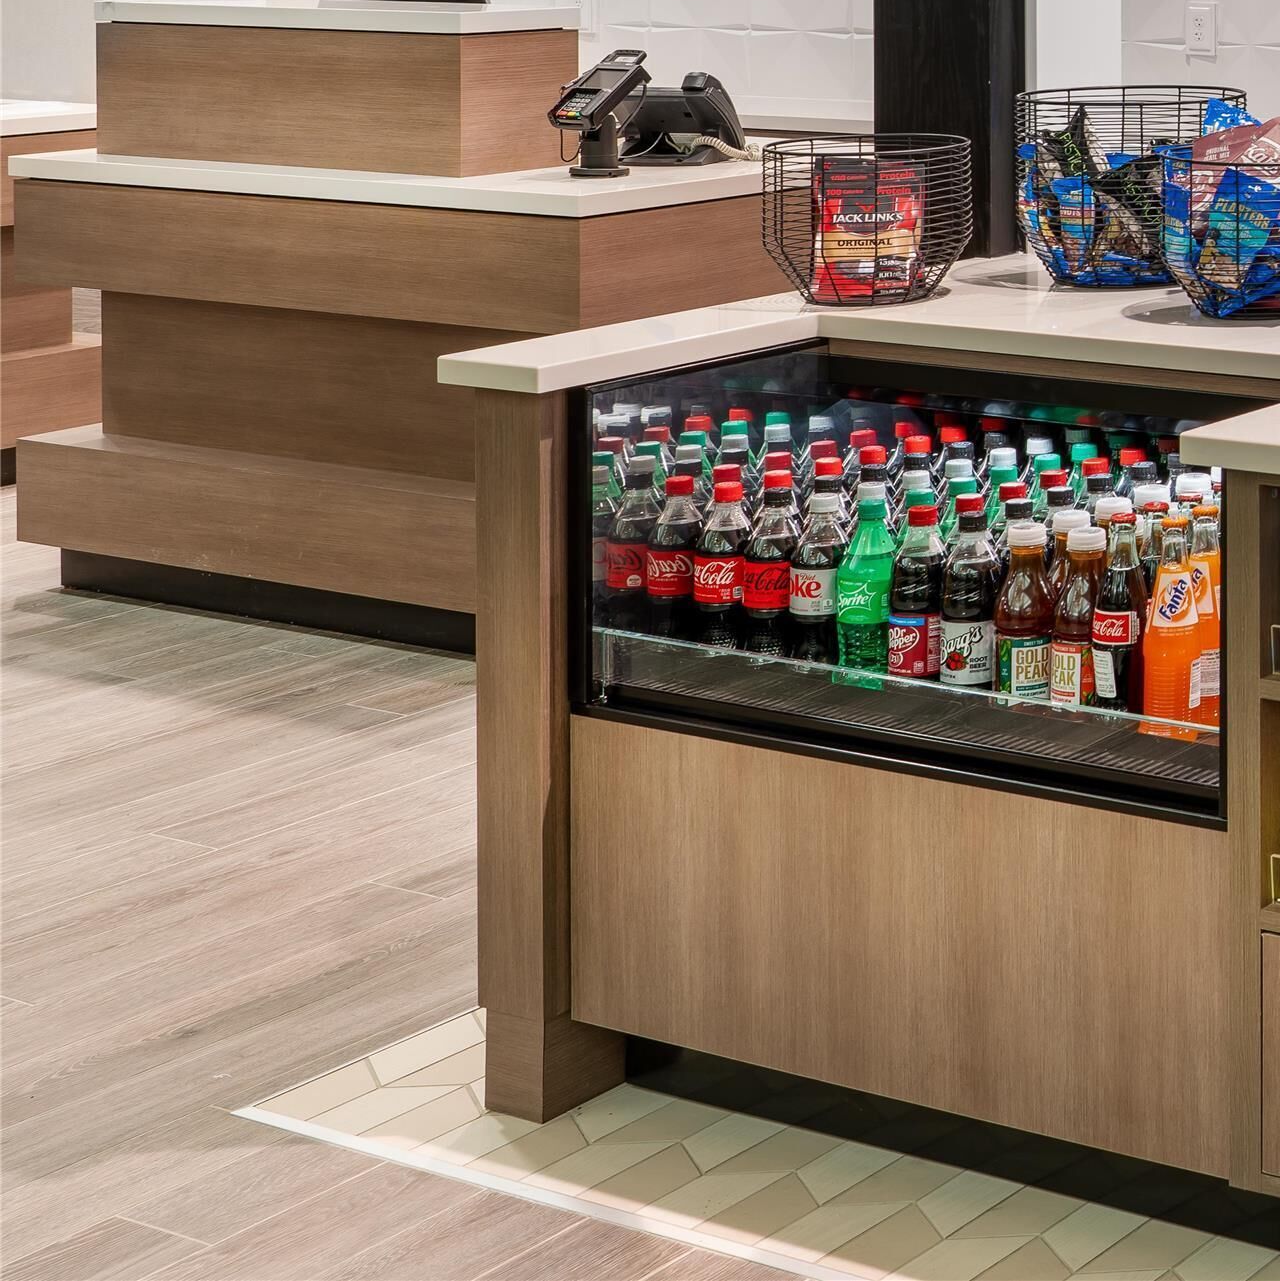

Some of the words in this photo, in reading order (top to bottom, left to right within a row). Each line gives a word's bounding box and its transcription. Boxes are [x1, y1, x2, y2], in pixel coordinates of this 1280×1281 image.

[832, 212, 864, 224] JACK
[837, 238, 893, 247] ORIGINAL
[800, 573, 816, 581] Diet
[838, 592, 870, 608] Sprite
[1158, 577, 1188, 622] Fanta
[940, 625, 984, 662] Barq's
[969, 656, 989, 665] ROOT
[1015, 647, 1049, 666] GOLD
[969, 662, 988, 670] BEER
[1015, 662, 1050, 681] PEAK
